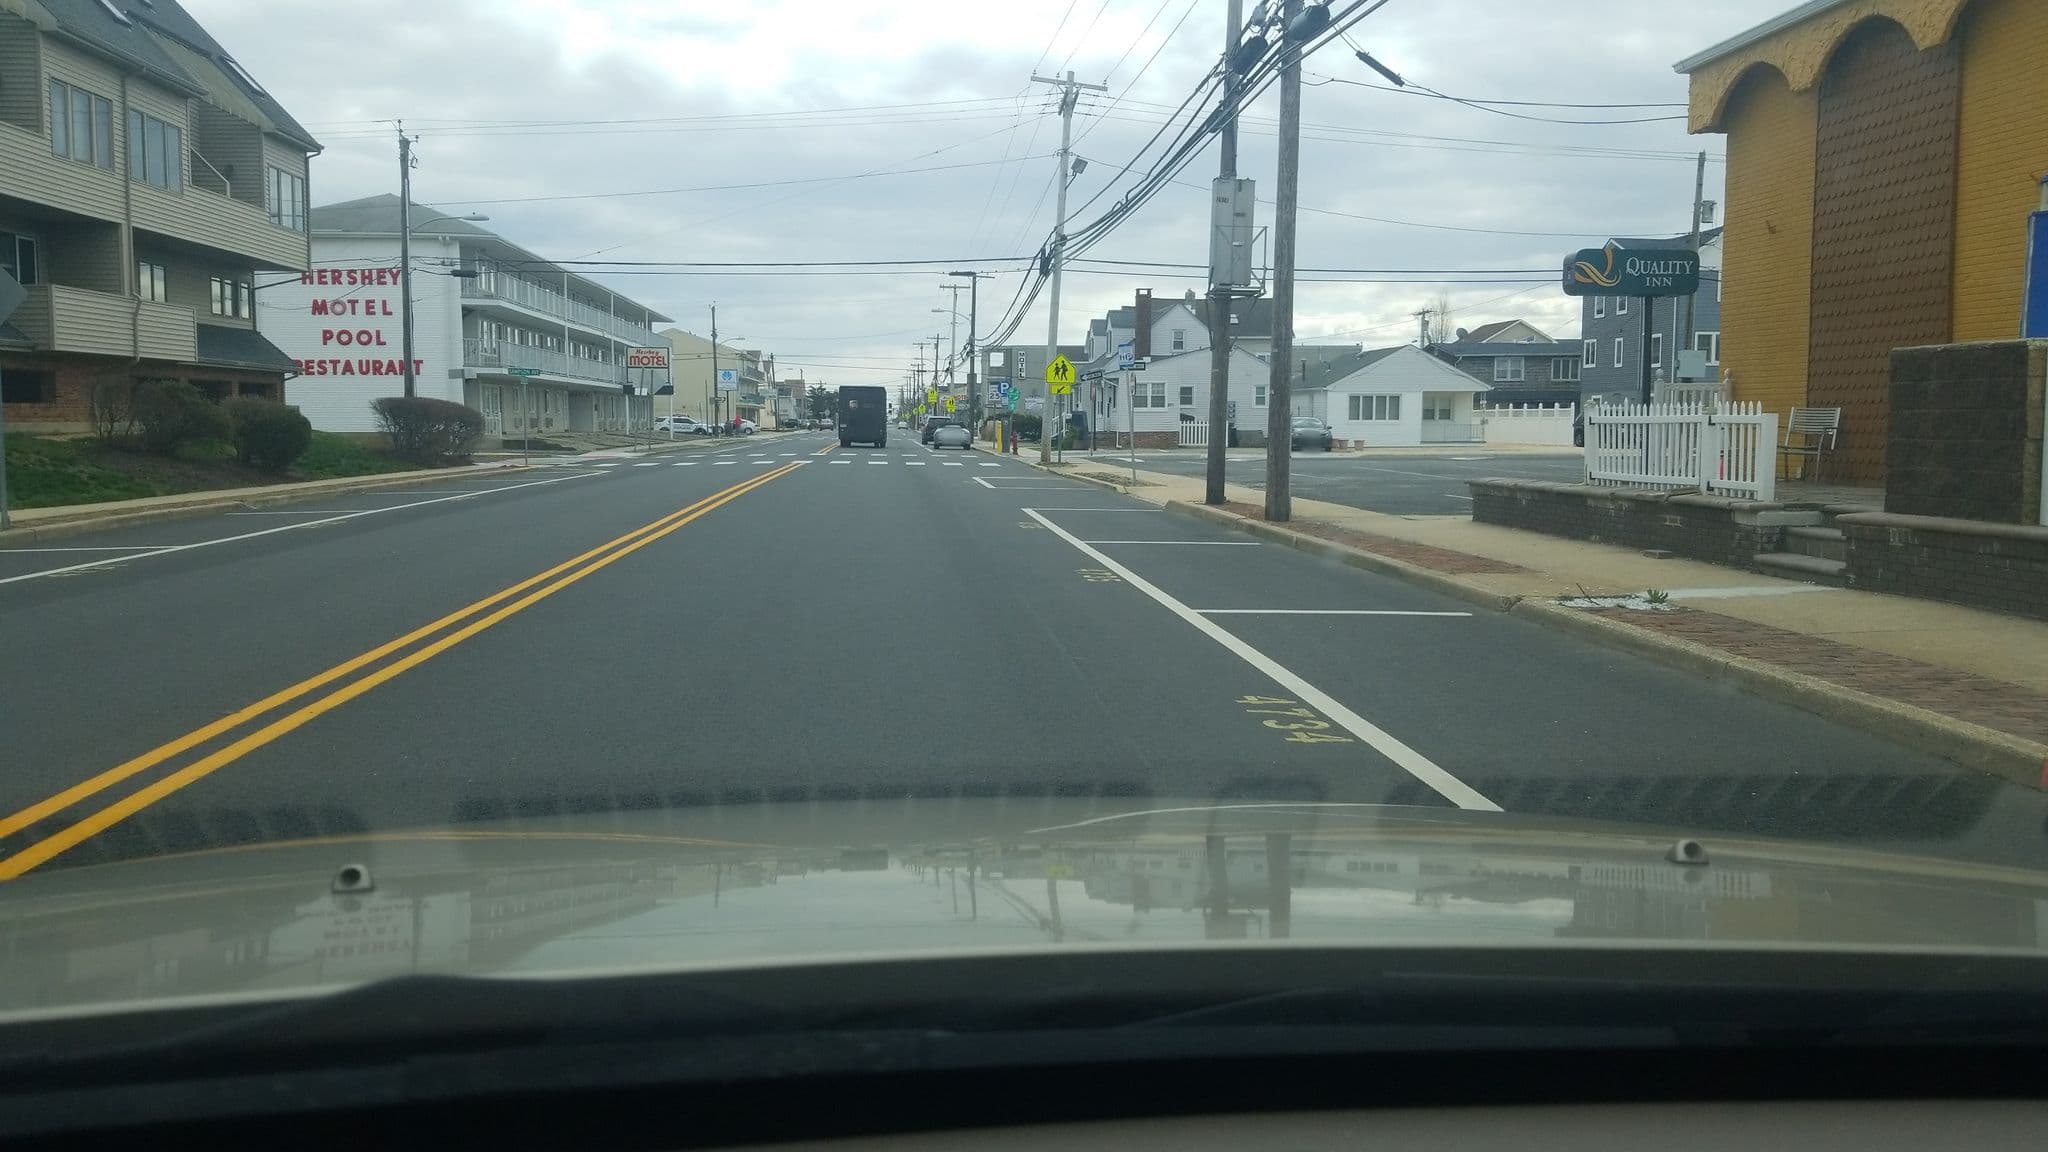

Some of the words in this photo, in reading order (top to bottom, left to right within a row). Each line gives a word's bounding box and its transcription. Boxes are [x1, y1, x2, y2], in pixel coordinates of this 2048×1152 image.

[1626, 256, 1693, 276] QUALITY
[301, 268, 402, 286] HERSHEY
[1646, 277, 1672, 287] INN
[311, 299, 393, 316] MOTEL
[322, 329, 387, 346] POOL
[629, 355, 667, 366] MOTEL
[989, 392, 1000, 400] 25
